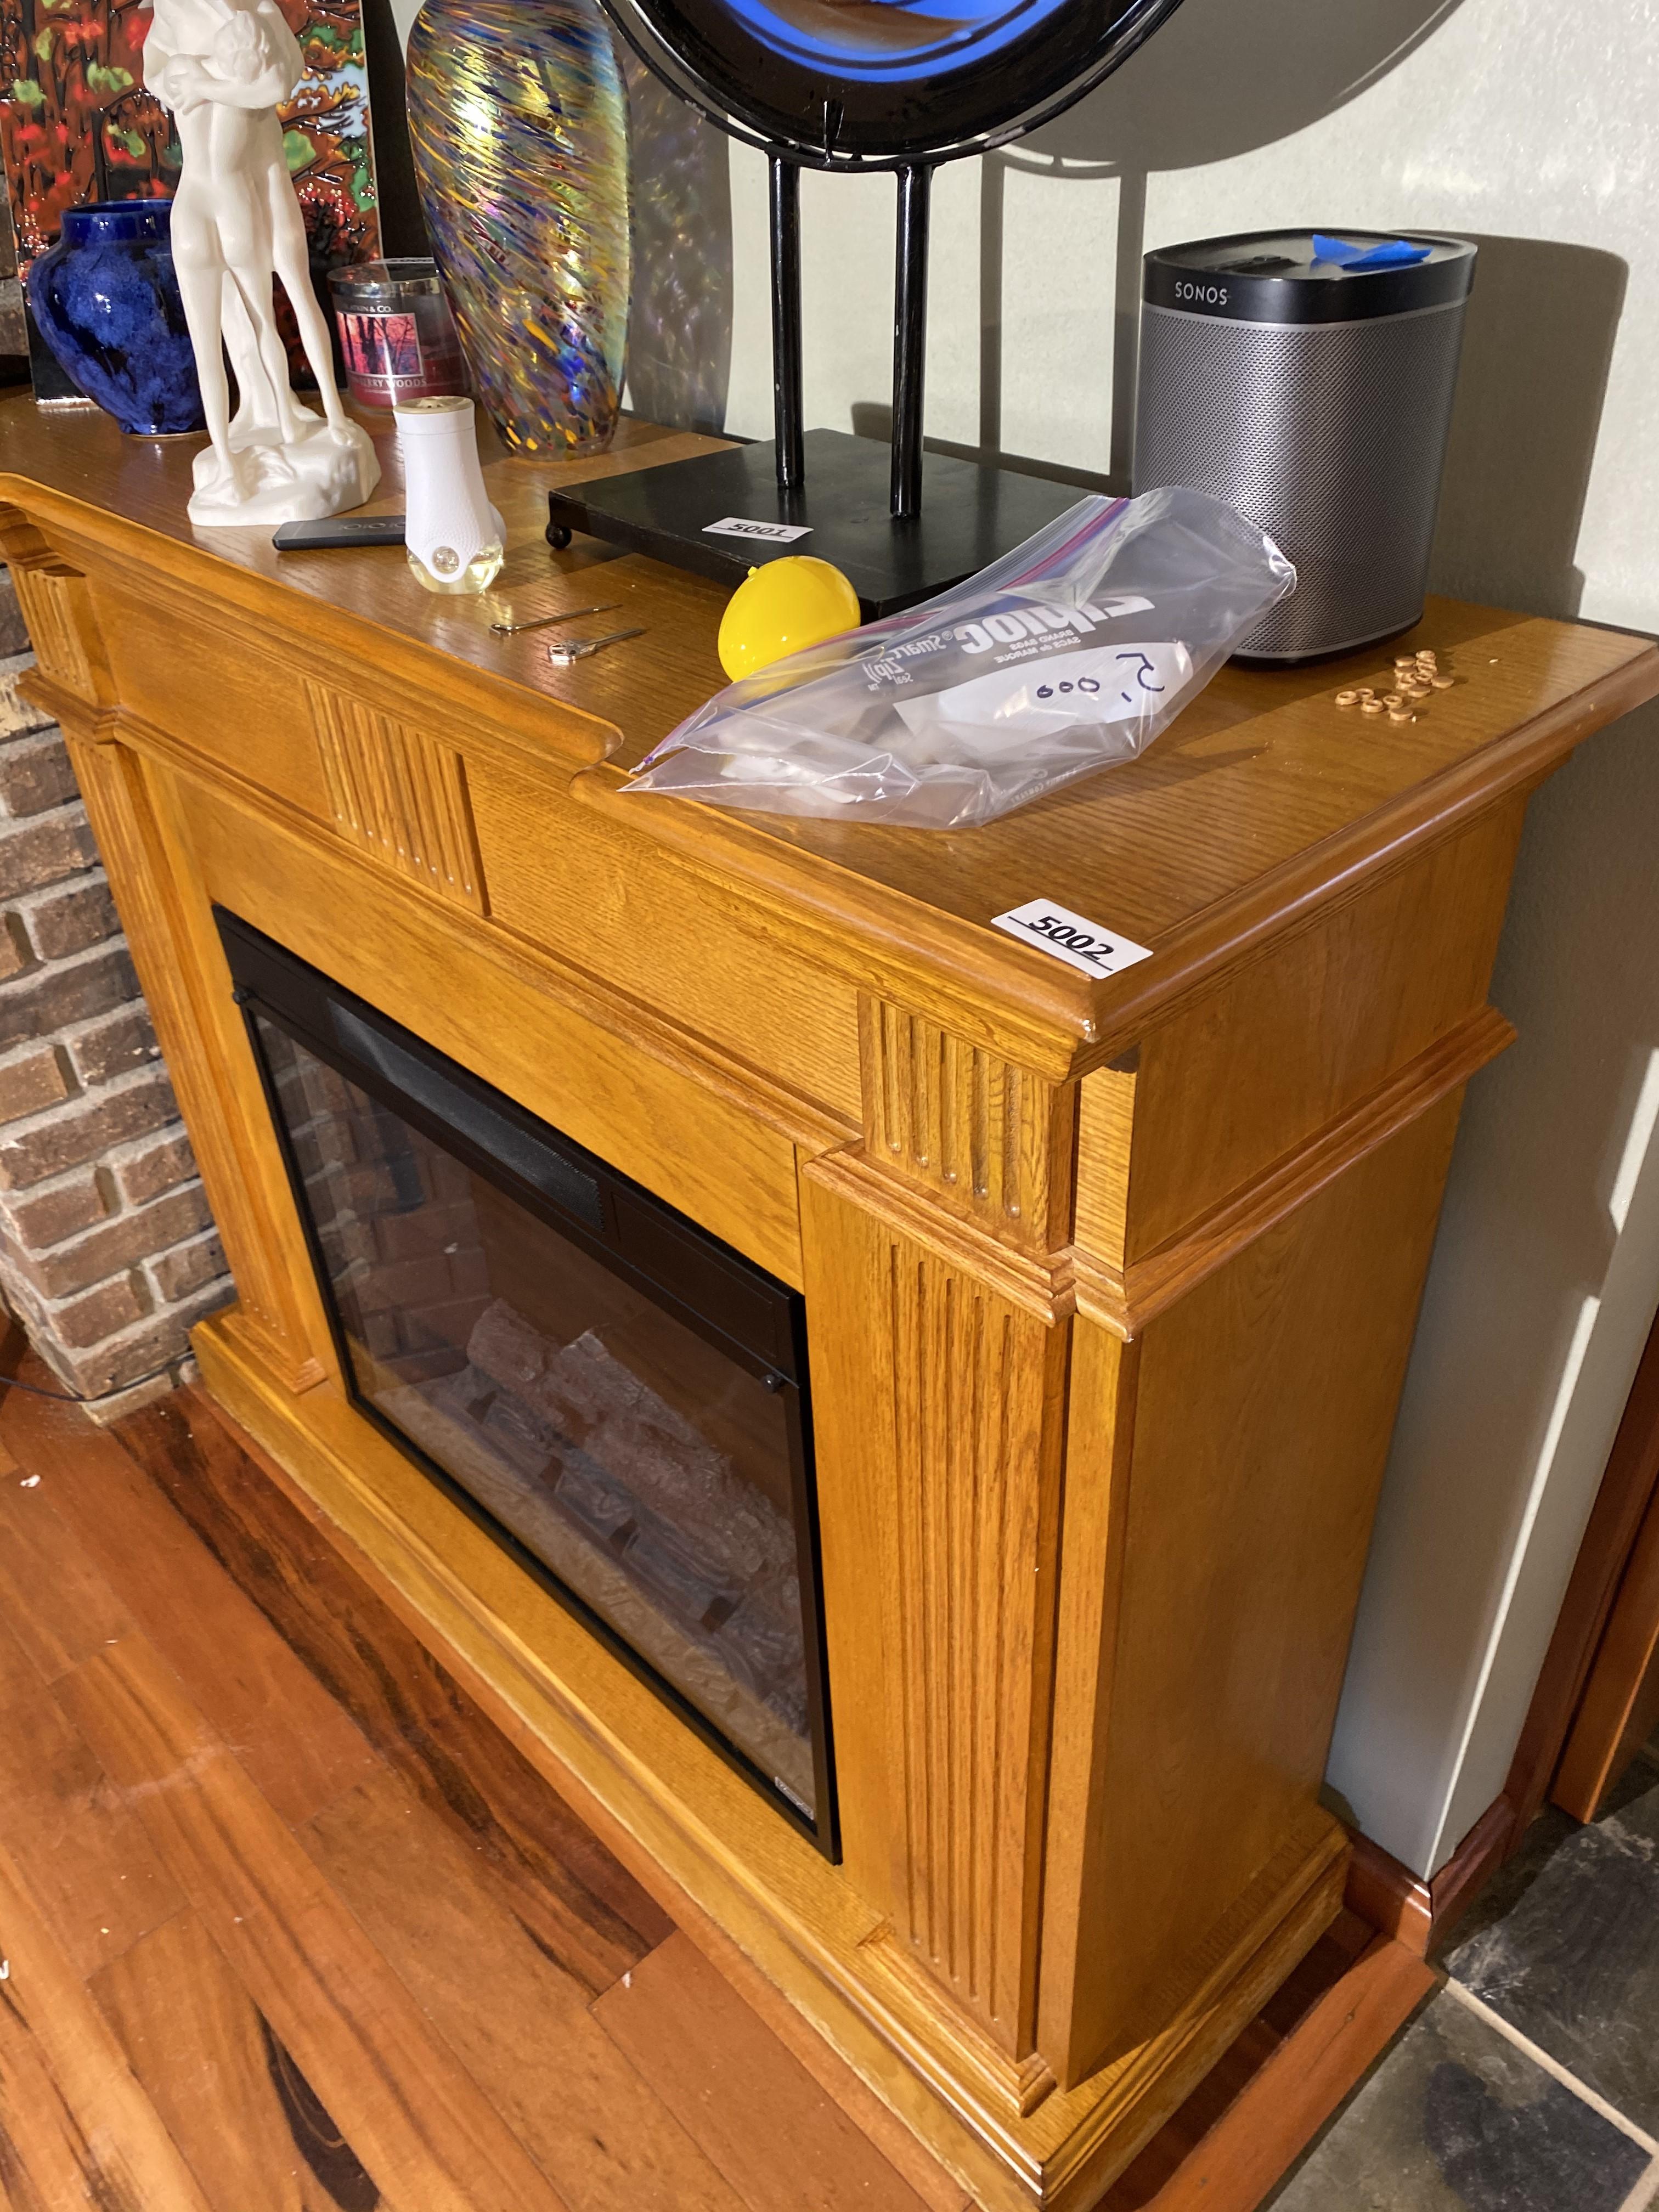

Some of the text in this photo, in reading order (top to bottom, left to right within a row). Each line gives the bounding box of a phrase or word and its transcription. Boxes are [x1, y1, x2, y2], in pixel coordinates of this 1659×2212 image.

[1175, 281, 1228, 306] SONOS
[385, 378, 427, 387] WOODS
[728, 523, 787, 536] 5001
[1028, 916, 1115, 961] 5002
